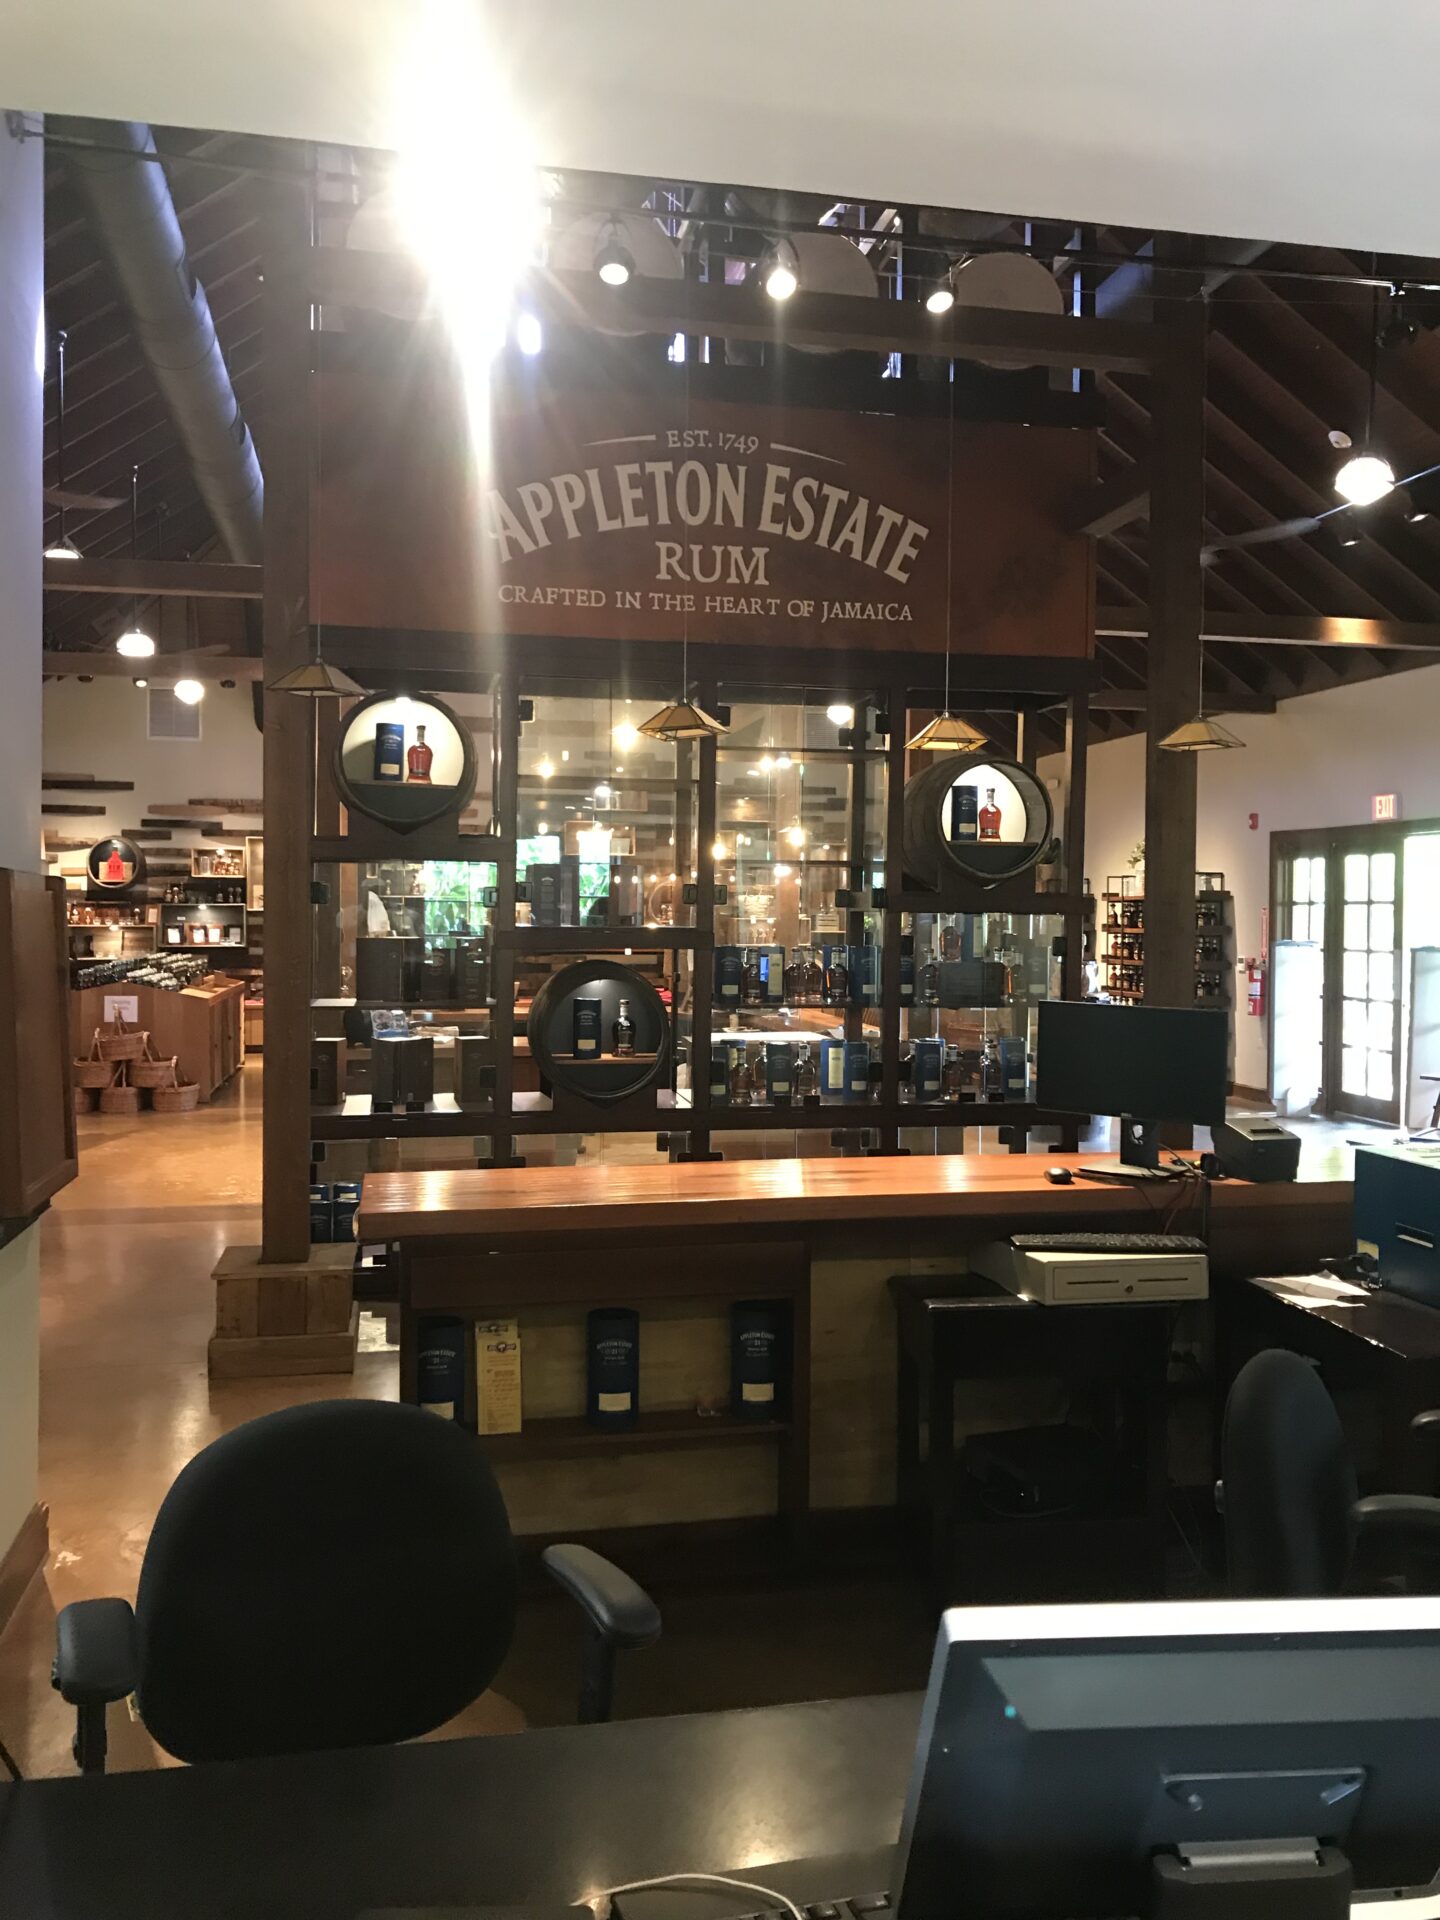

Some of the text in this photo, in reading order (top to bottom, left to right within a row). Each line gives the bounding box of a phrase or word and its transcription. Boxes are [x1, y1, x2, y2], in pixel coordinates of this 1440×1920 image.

[666, 430, 759, 455] EST. 1749
[486, 459, 930, 584] APPLETON ESTATE
[654, 541, 770, 586] RUM
[498, 584, 914, 623] CRAFTED IN THE HEART OF JAMAICA
[1375, 794, 1394, 819] EXIT
